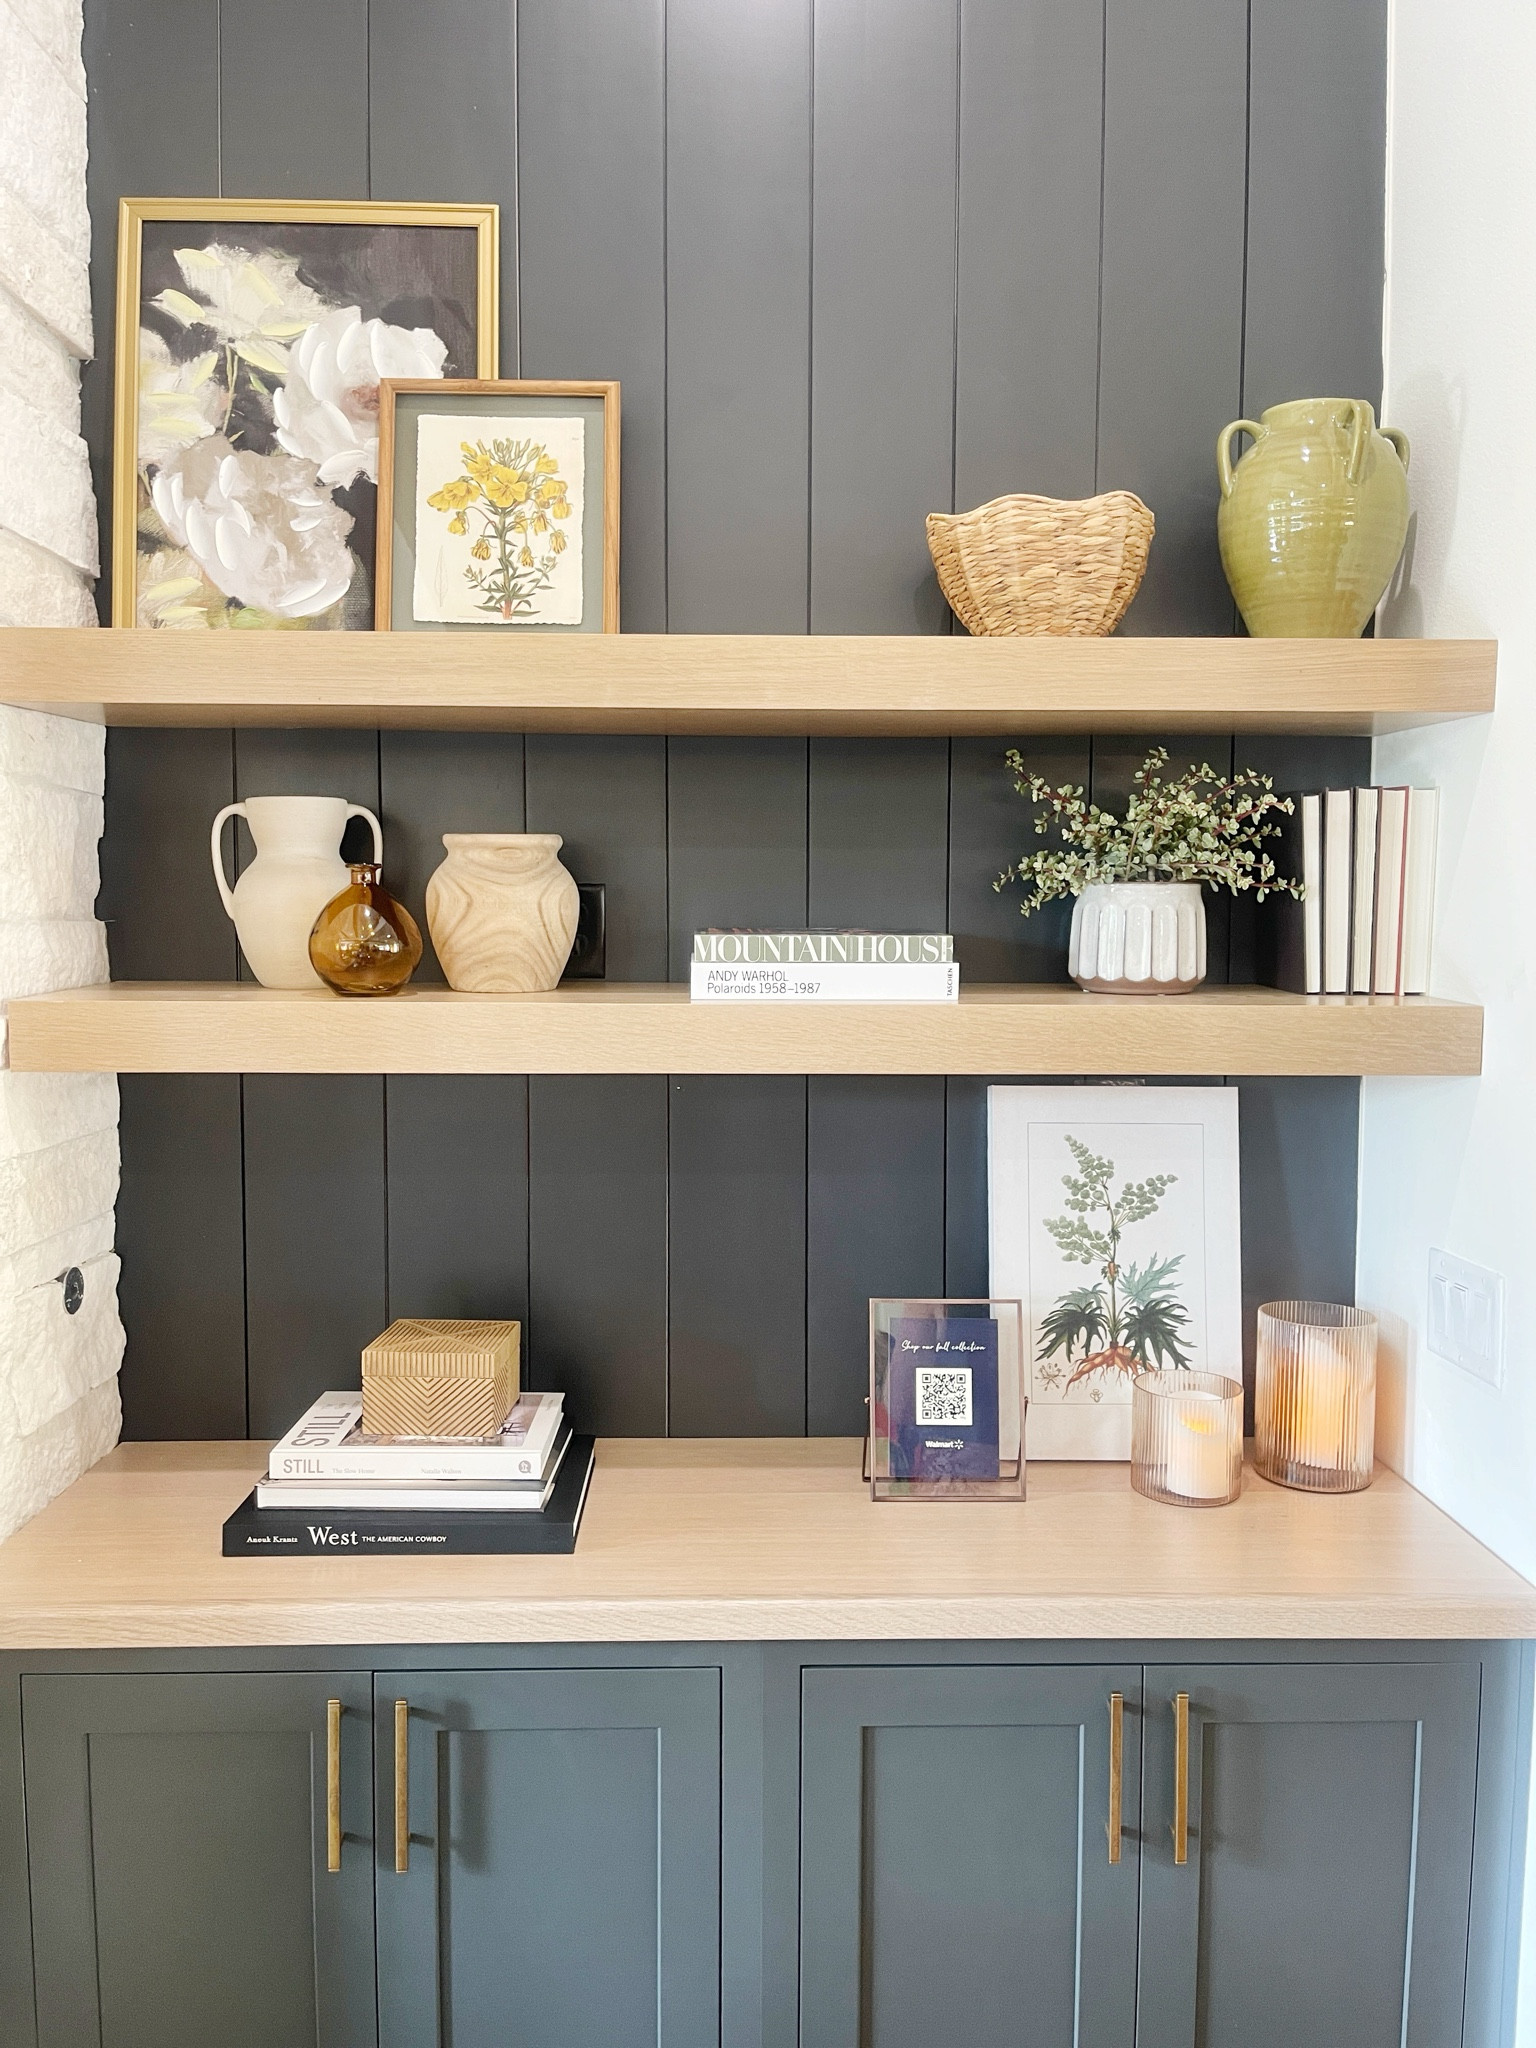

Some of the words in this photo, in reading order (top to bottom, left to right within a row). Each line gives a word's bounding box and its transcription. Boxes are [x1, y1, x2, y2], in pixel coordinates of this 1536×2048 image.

[693, 935, 848, 963] MOUNTAIN
[707, 970, 739, 982] ANDY
[742, 970, 789, 982] WARHOL
[707, 982, 756, 994] Polaroids
[901, 1339, 921, 1354] Shop
[951, 1341, 986, 1353] collection
[291, 1412, 352, 1447] STILL
[925, 1440, 954, 1449] Walmart
[282, 1458, 324, 1474] STILL
[246, 1535, 271, 1543] Anouk
[307, 1526, 359, 1546] West
[362, 1535, 376, 1543] THE
[377, 1535, 414, 1543] AMERICAN
[415, 1535, 447, 1543] COWBOY
